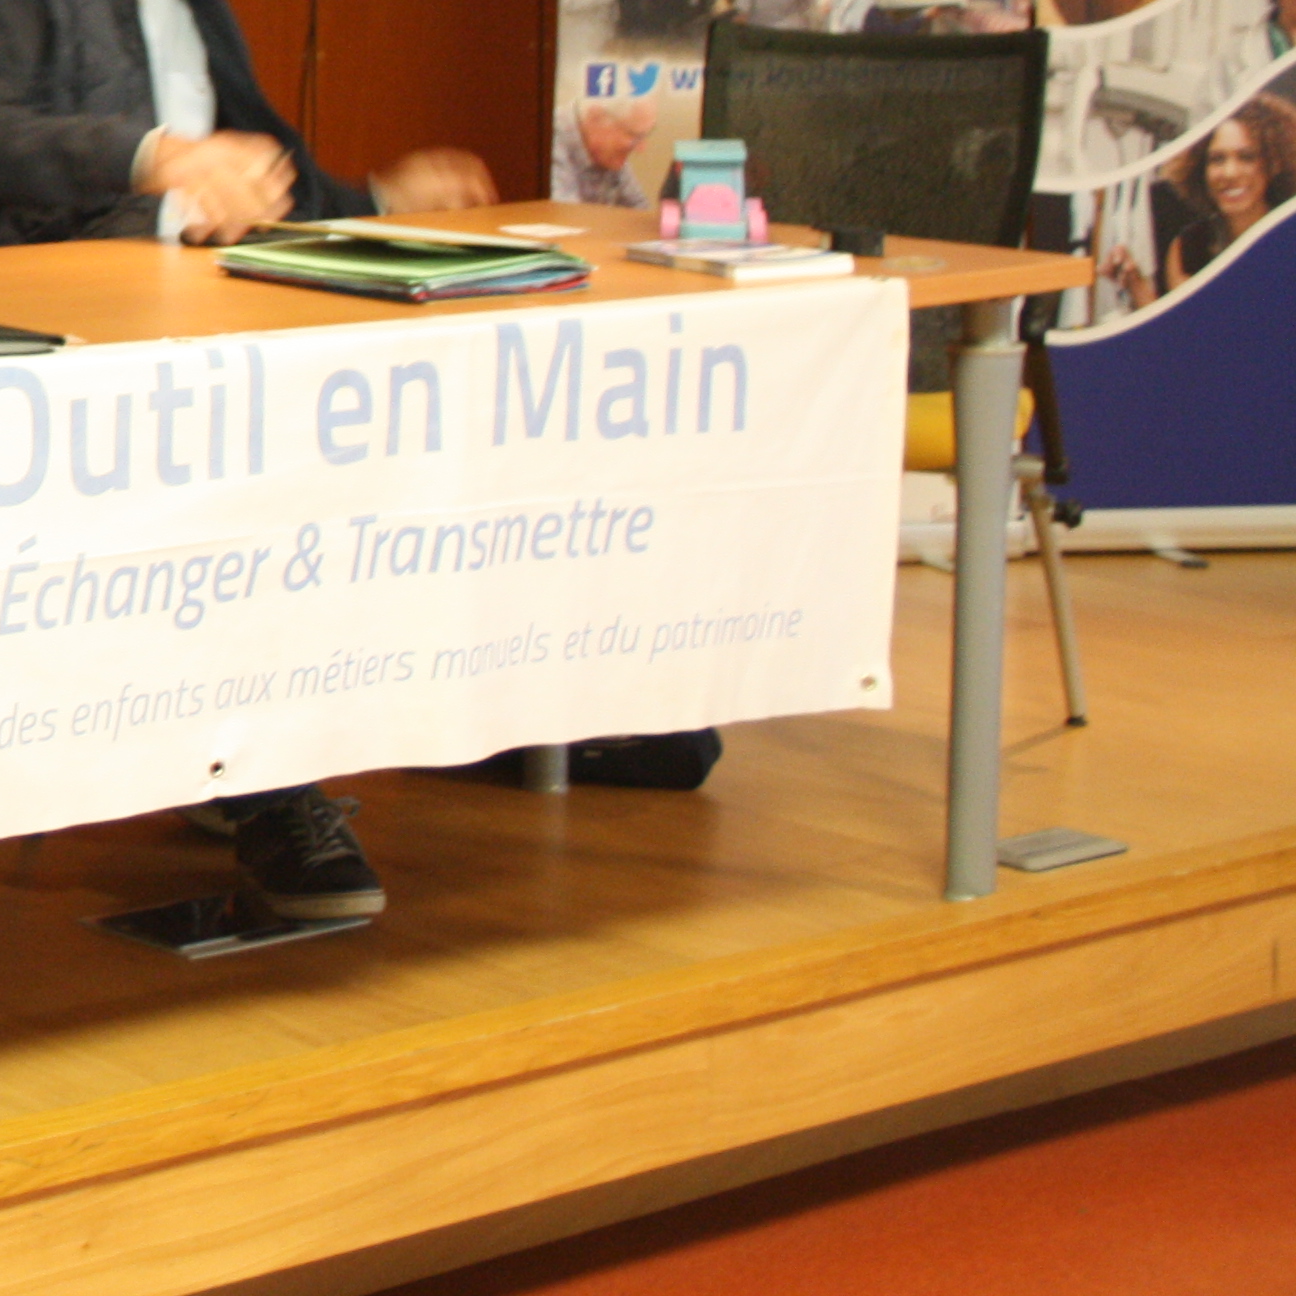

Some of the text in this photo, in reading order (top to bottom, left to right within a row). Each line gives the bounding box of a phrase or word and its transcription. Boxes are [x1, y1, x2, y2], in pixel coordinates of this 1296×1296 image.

[315, 359, 443, 467] en
[491, 312, 750, 447] Main
[282, 522, 325, 592] &
[348, 497, 655, 585] Transmettre
[70, 678, 206, 742] enfants
[213, 670, 278, 711] aux
[285, 650, 415, 700] métiers
[430, 621, 550, 682] manuels
[563, 625, 592, 661] et
[598, 614, 641, 656] du
[647, 605, 804, 665] patrimoine
